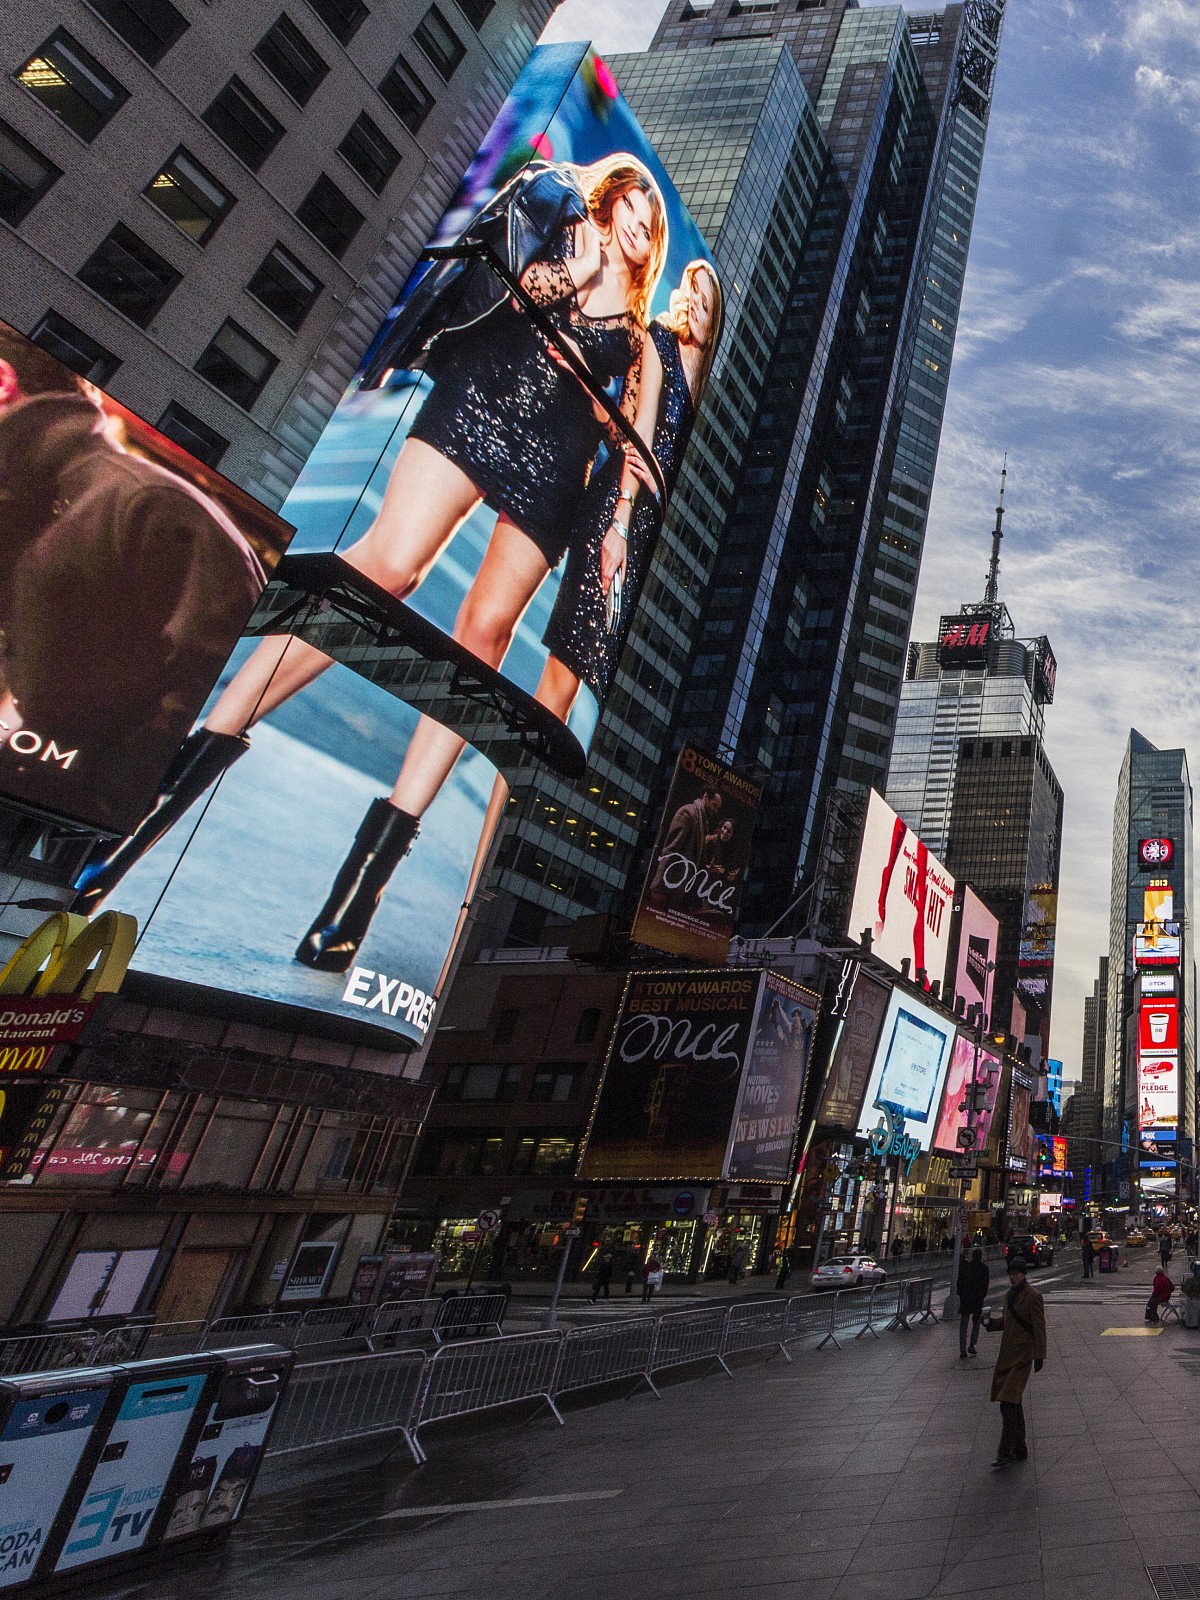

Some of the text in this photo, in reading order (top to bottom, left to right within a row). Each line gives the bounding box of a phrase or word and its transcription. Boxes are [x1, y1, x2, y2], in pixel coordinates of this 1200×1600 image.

[698, 756, 723, 776] TONY
[723, 772, 760, 798] AWARDS
[927, 889, 946, 938] HIT
[1137, 956, 1179, 965] TOSHIBA
[646, 982, 690, 996] TONY
[688, 980, 753, 995] AWARDS
[629, 997, 748, 1013] BEST MUSICAL
[1142, 1132, 1155, 1140] FOX
[65, 1488, 126, 1556] 3
[111, 1508, 156, 1542] TV
[0, 1528, 42, 1554] ODA
